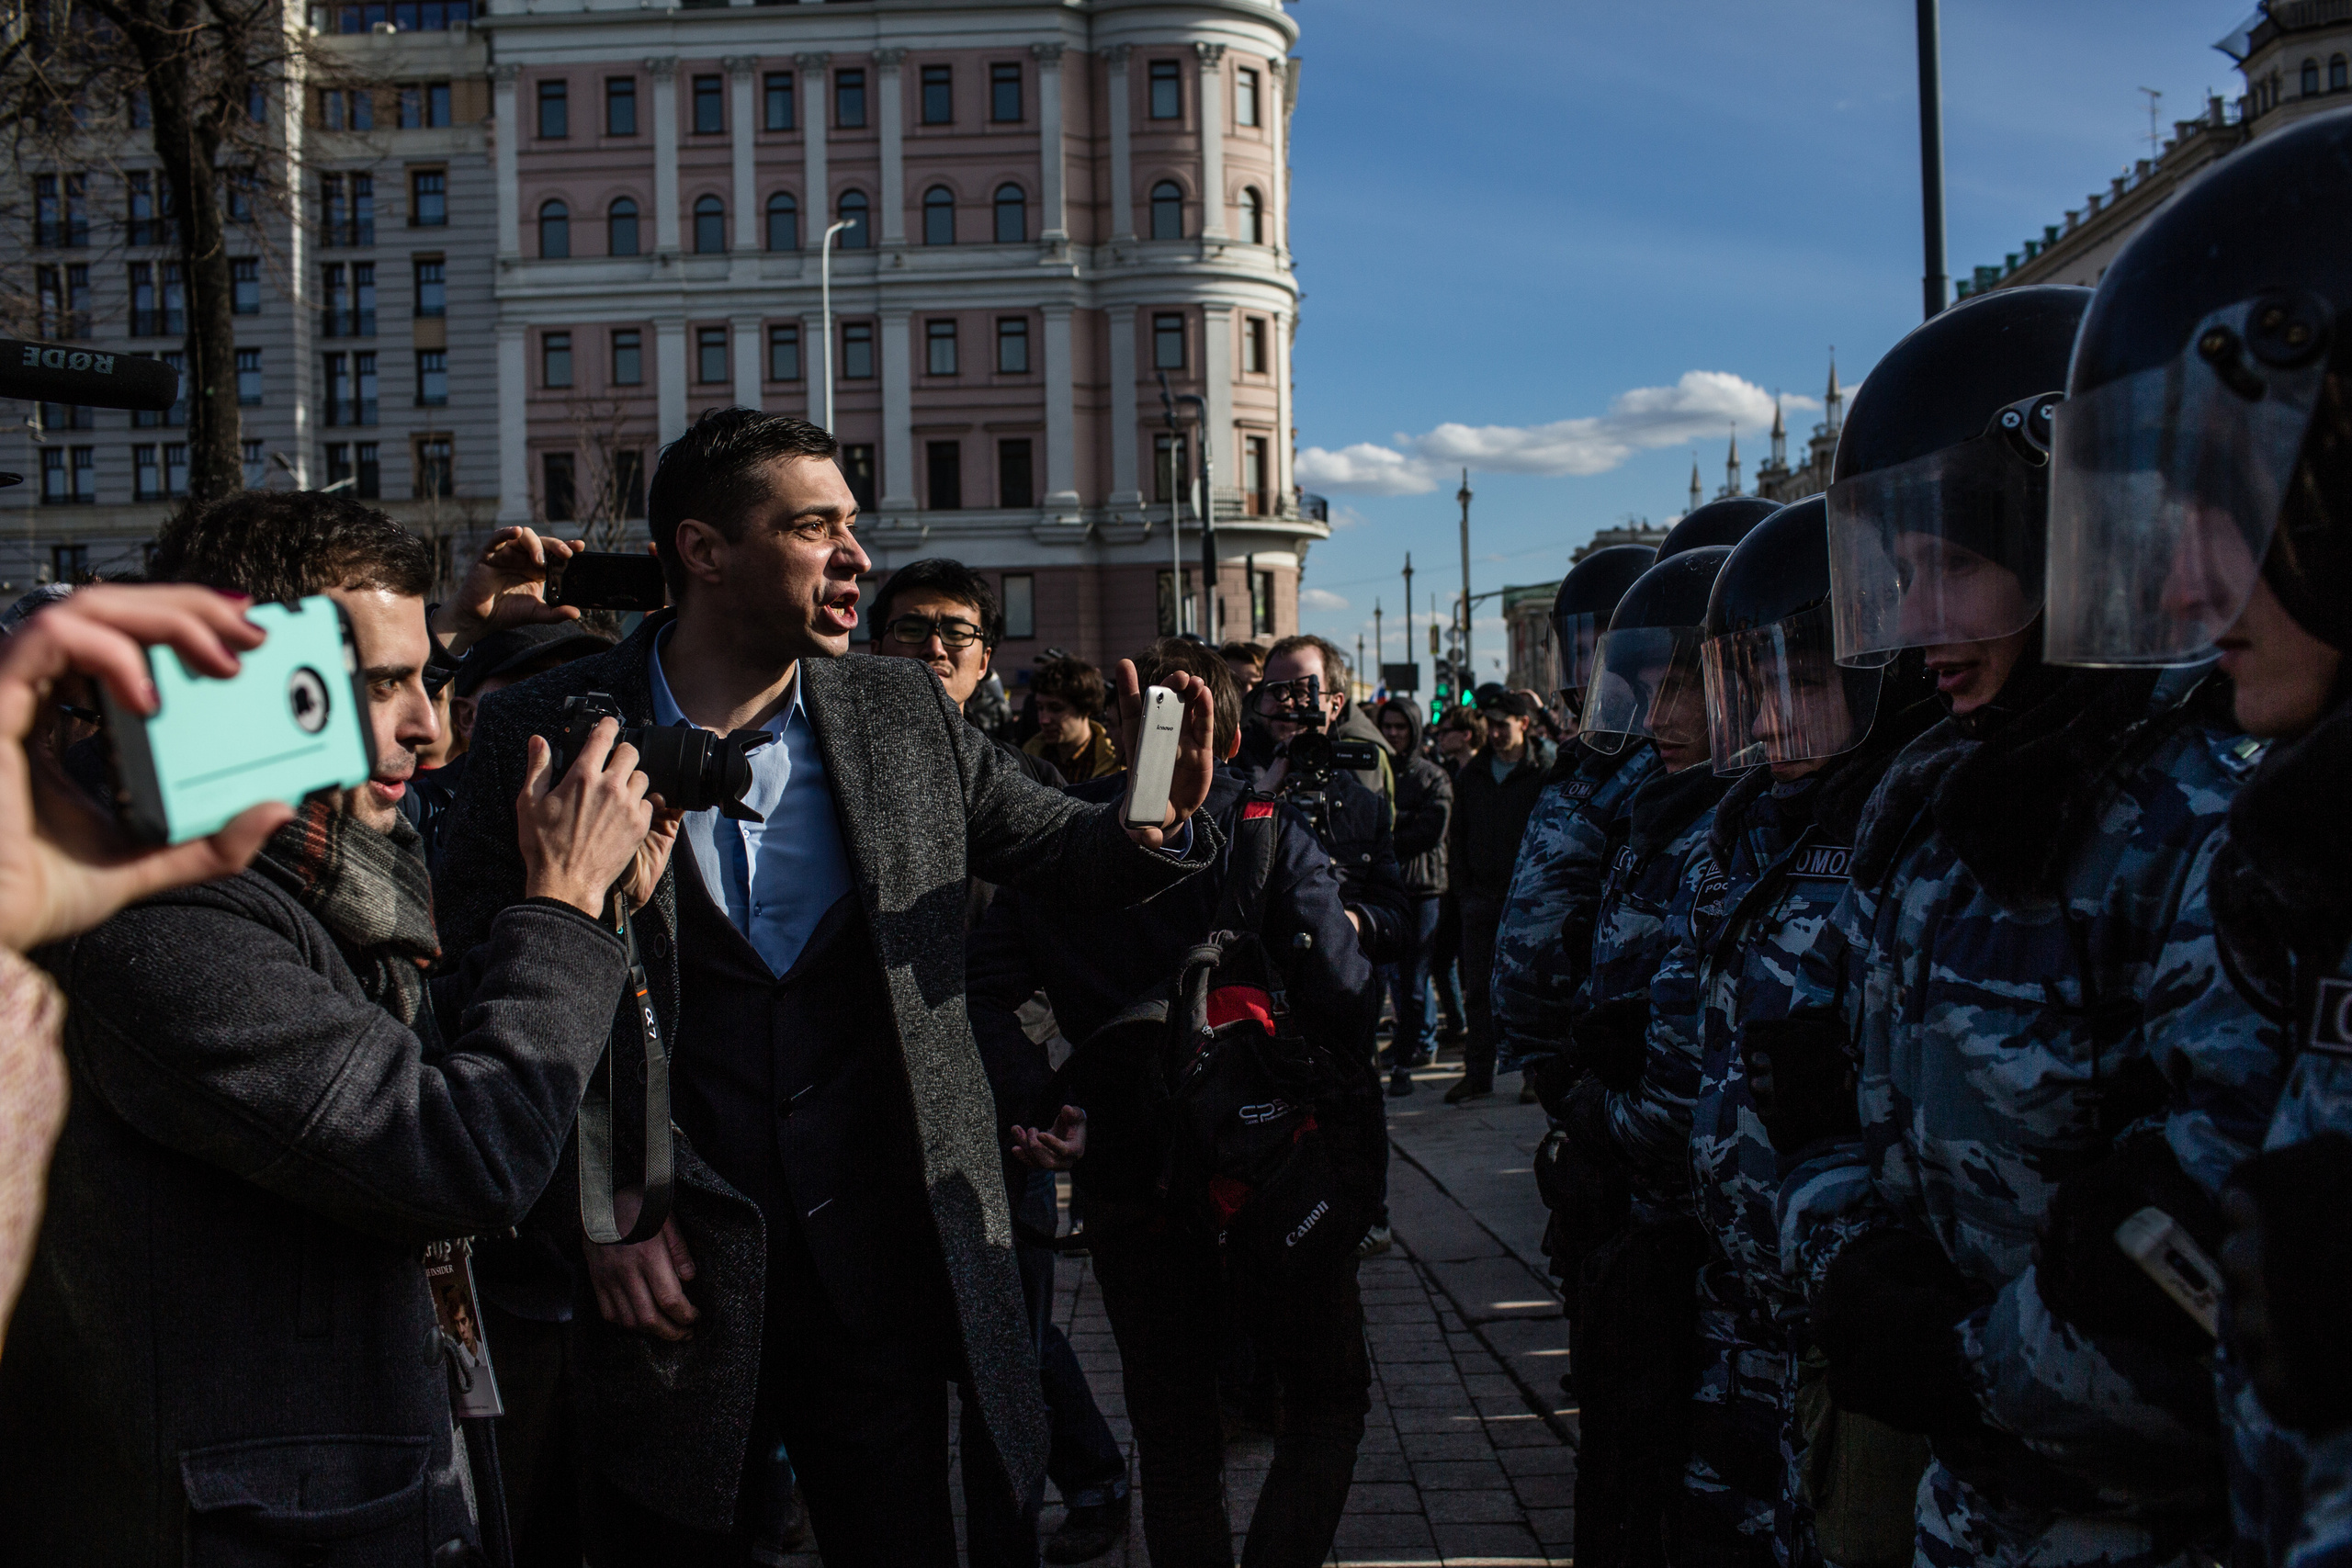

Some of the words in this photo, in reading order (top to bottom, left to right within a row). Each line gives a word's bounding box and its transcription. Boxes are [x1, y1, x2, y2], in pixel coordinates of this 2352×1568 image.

[23, 345, 115, 375] RØDE
[1568, 784, 1592, 796] ОМ
[1705, 882, 1728, 894] РОС
[1286, 1200, 1329, 1247] Canon
